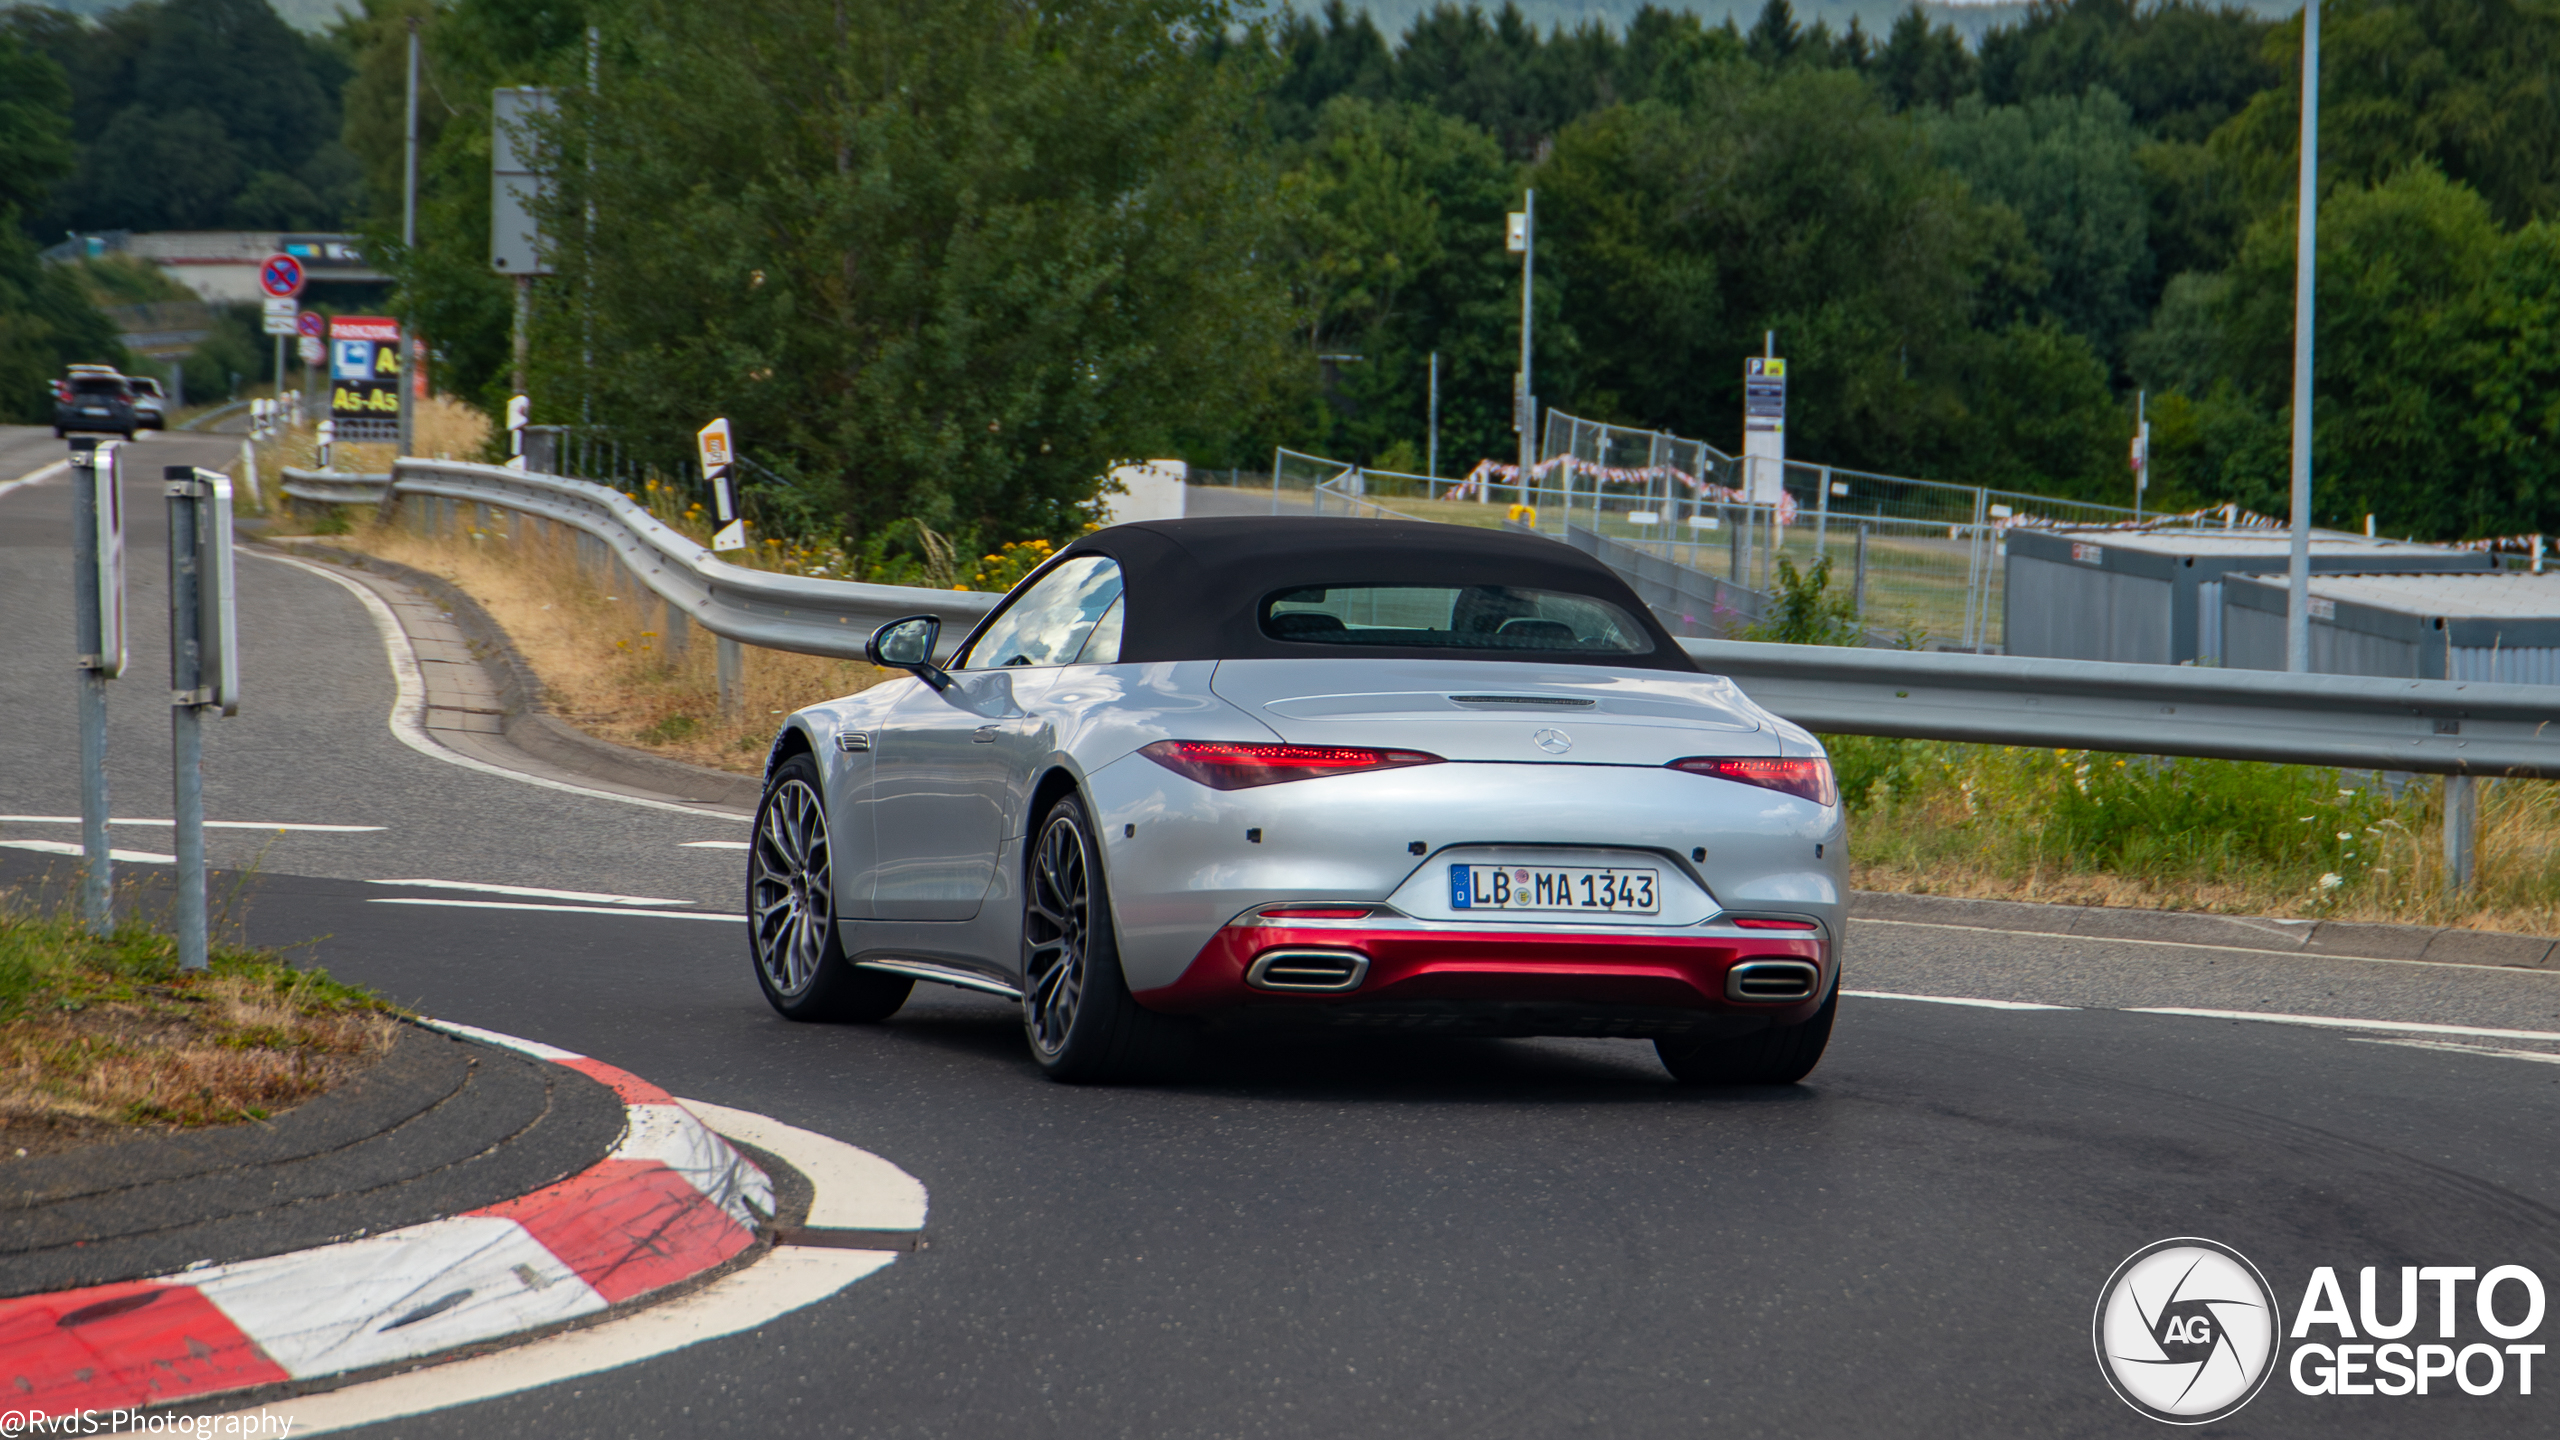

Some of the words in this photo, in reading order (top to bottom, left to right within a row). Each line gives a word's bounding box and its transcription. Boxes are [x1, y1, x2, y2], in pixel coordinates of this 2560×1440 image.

[1473, 871, 1511, 904] LB
[1535, 872, 1573, 906] MA
[1580, 874, 1653, 908] 1343
